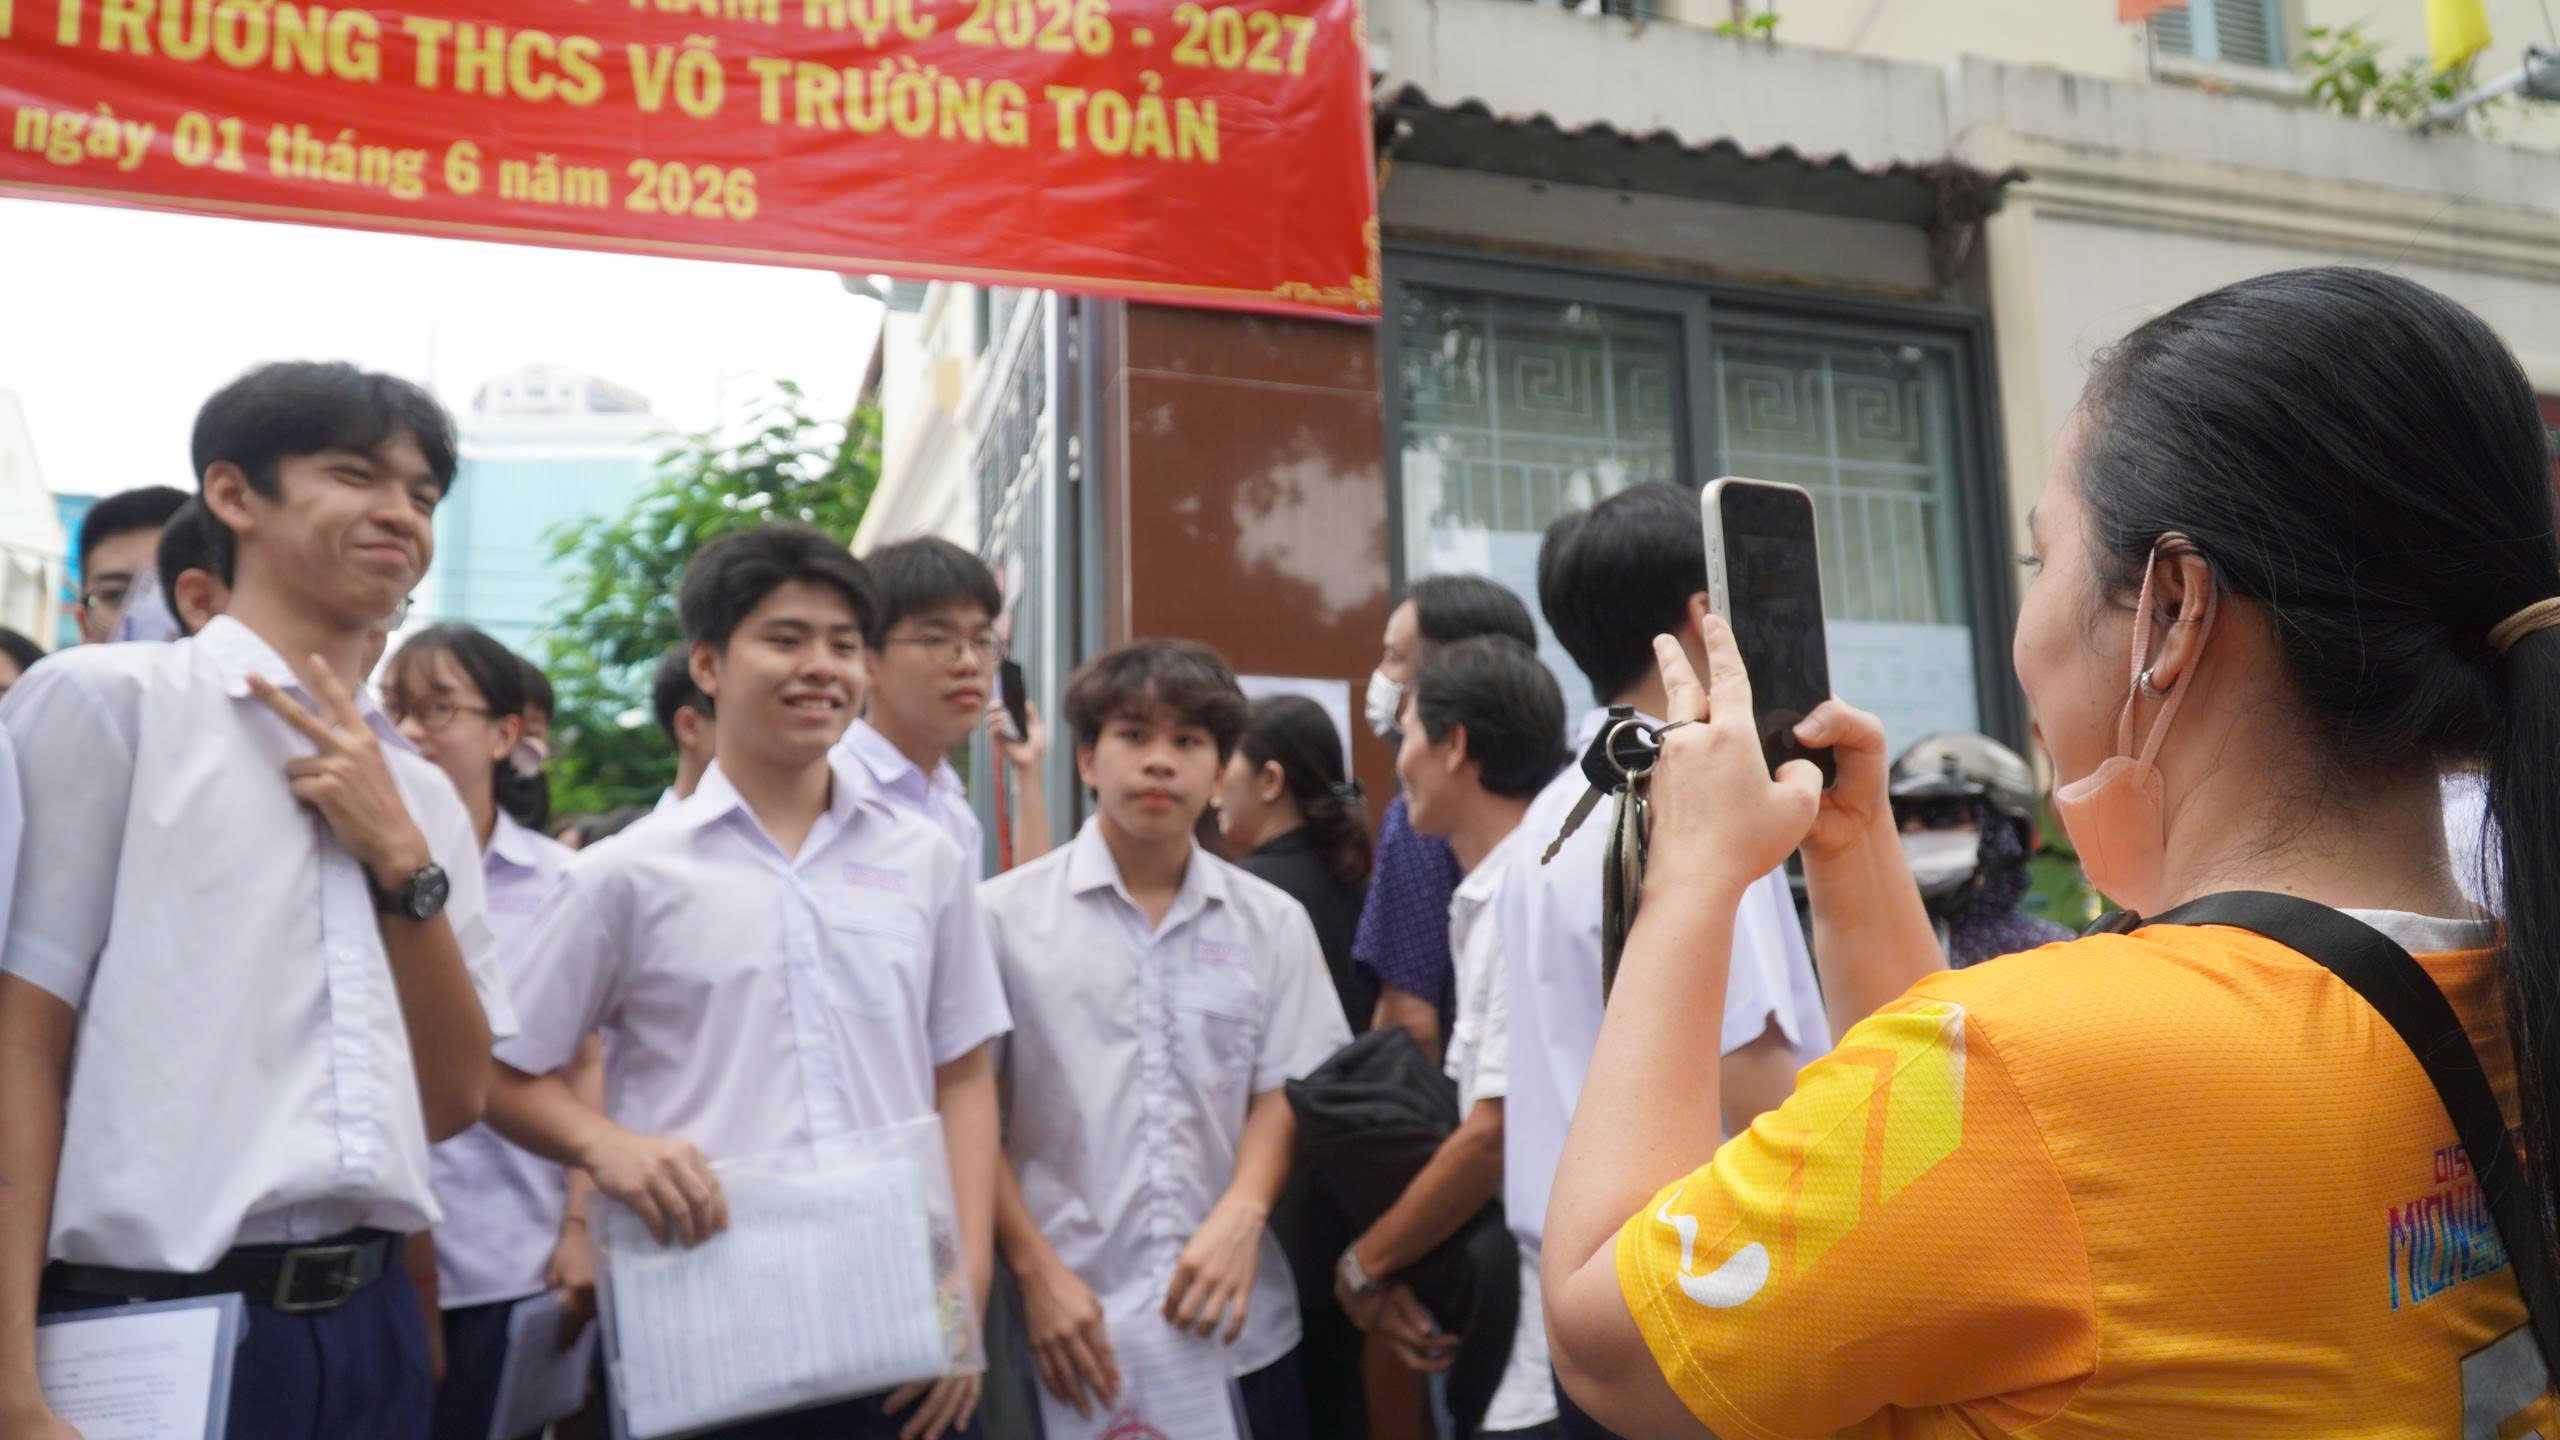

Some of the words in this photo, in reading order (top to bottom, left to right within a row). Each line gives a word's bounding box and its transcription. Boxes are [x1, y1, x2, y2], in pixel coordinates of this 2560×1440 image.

[955, 0, 1114, 57] 2026
[1132, 27, 1154, 47] -
[1172, 3, 1316, 76] 2027
[402, 15, 606, 106] THCS
[626, 34, 726, 119] VÕ
[747, 54, 1030, 148] TRƯỜNG
[1044, 70, 1220, 163] TOẢN
[13, 101, 156, 172] ngày
[171, 111, 246, 173] 01
[266, 124, 428, 201] tháng
[443, 141, 482, 196] 6
[497, 152, 610, 209] năm
[624, 158, 760, 222] 2026
[2433, 1144, 2470, 1183] DIS
